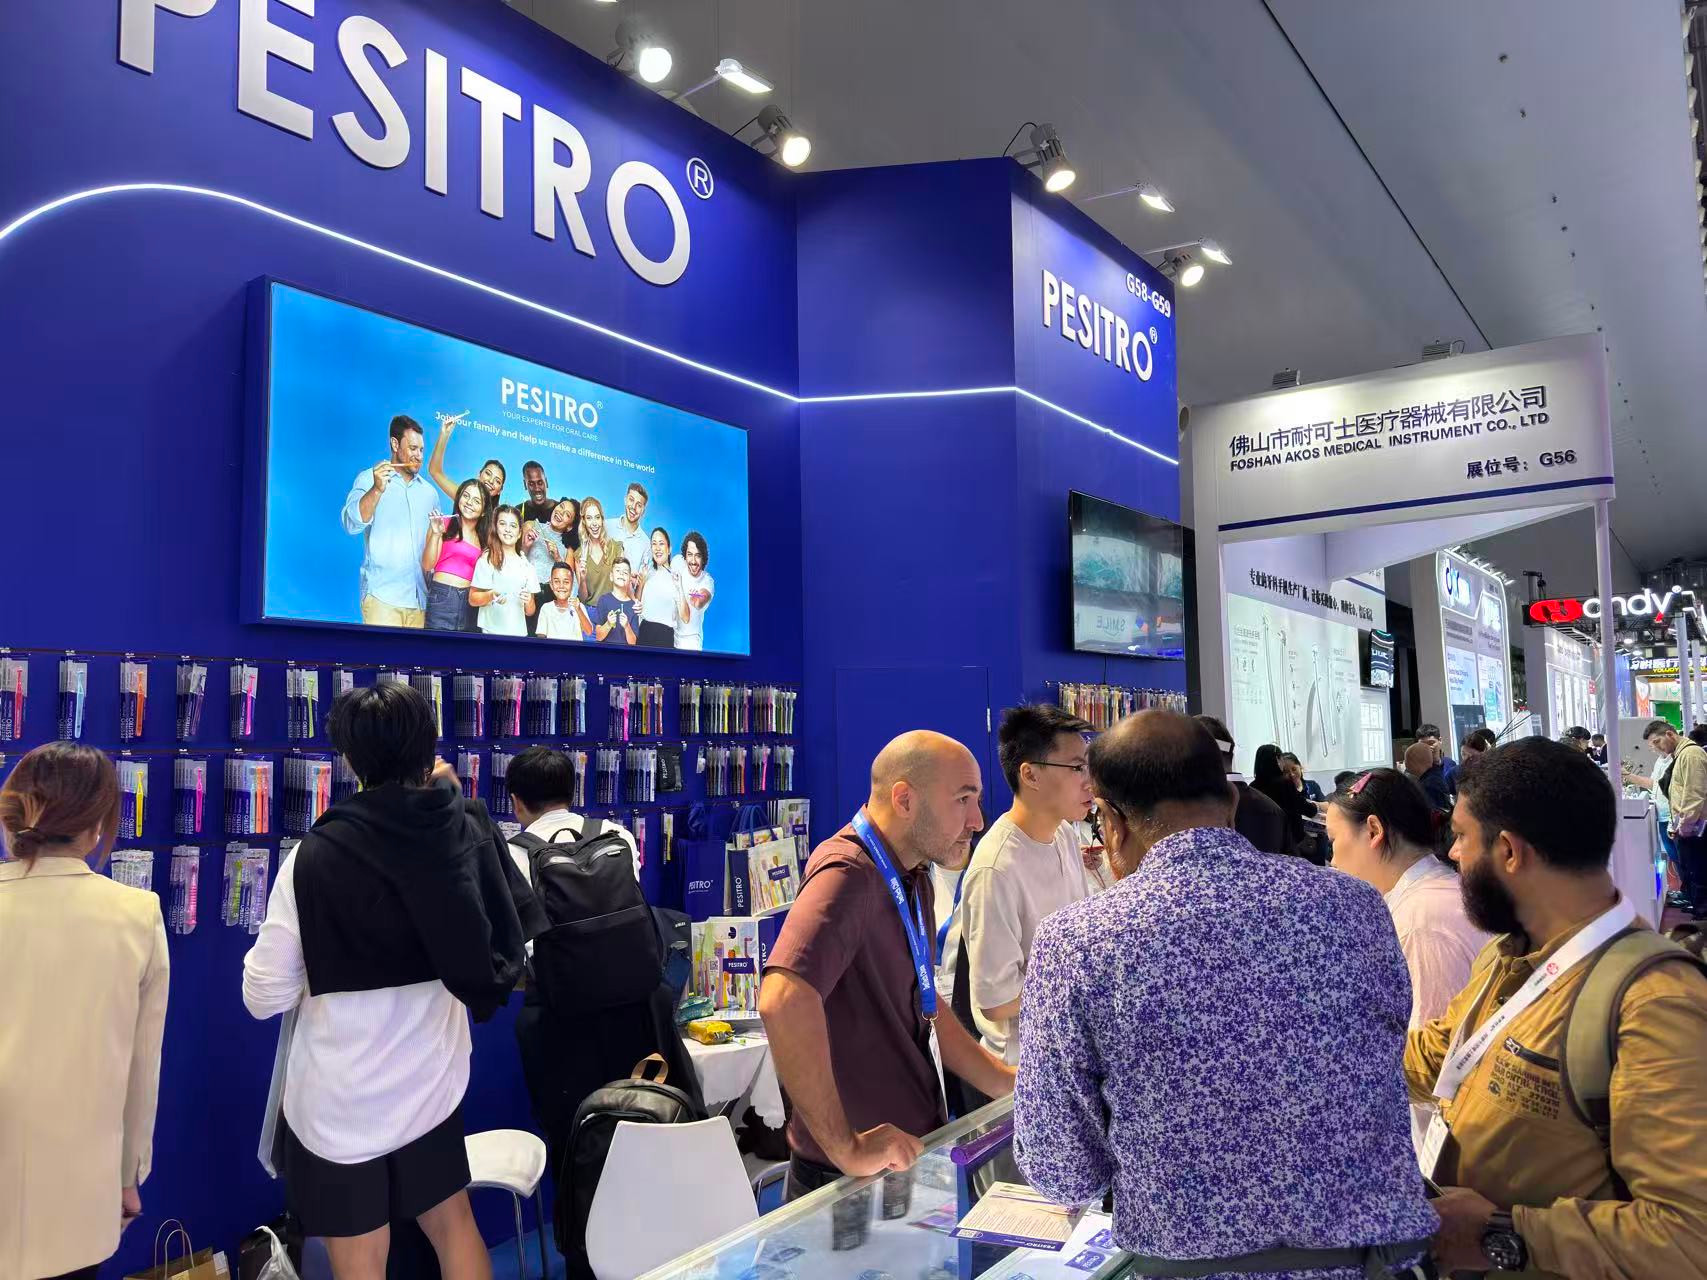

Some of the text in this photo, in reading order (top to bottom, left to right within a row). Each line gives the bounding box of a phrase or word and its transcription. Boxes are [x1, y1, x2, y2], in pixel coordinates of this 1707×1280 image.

[1126, 272, 1171, 318] G58-G59
[503, 411, 599, 442] YOUR EXPERTS FOR ORAL CARE
[1229, 385, 1547, 457] 佛山市耐可士医疗器械有限公司
[1230, 453, 1281, 472] FOSHAN
[1285, 448, 1320, 464] AKOS
[1324, 438, 1381, 458] MEDICAL
[1389, 422, 1482, 447] INSTRUMENT
[1520, 412, 1550, 428] LTD
[473, 421, 500, 437] family
[501, 428, 517, 439] and
[520, 430, 537, 445] help
[538, 438, 548, 447] us
[549, 440, 571, 454] make
[577, 447, 614, 464] difference
[615, 455, 622, 465] in
[623, 457, 635, 469] the
[635, 461, 655, 474] world
[1539, 450, 1577, 468] G56
